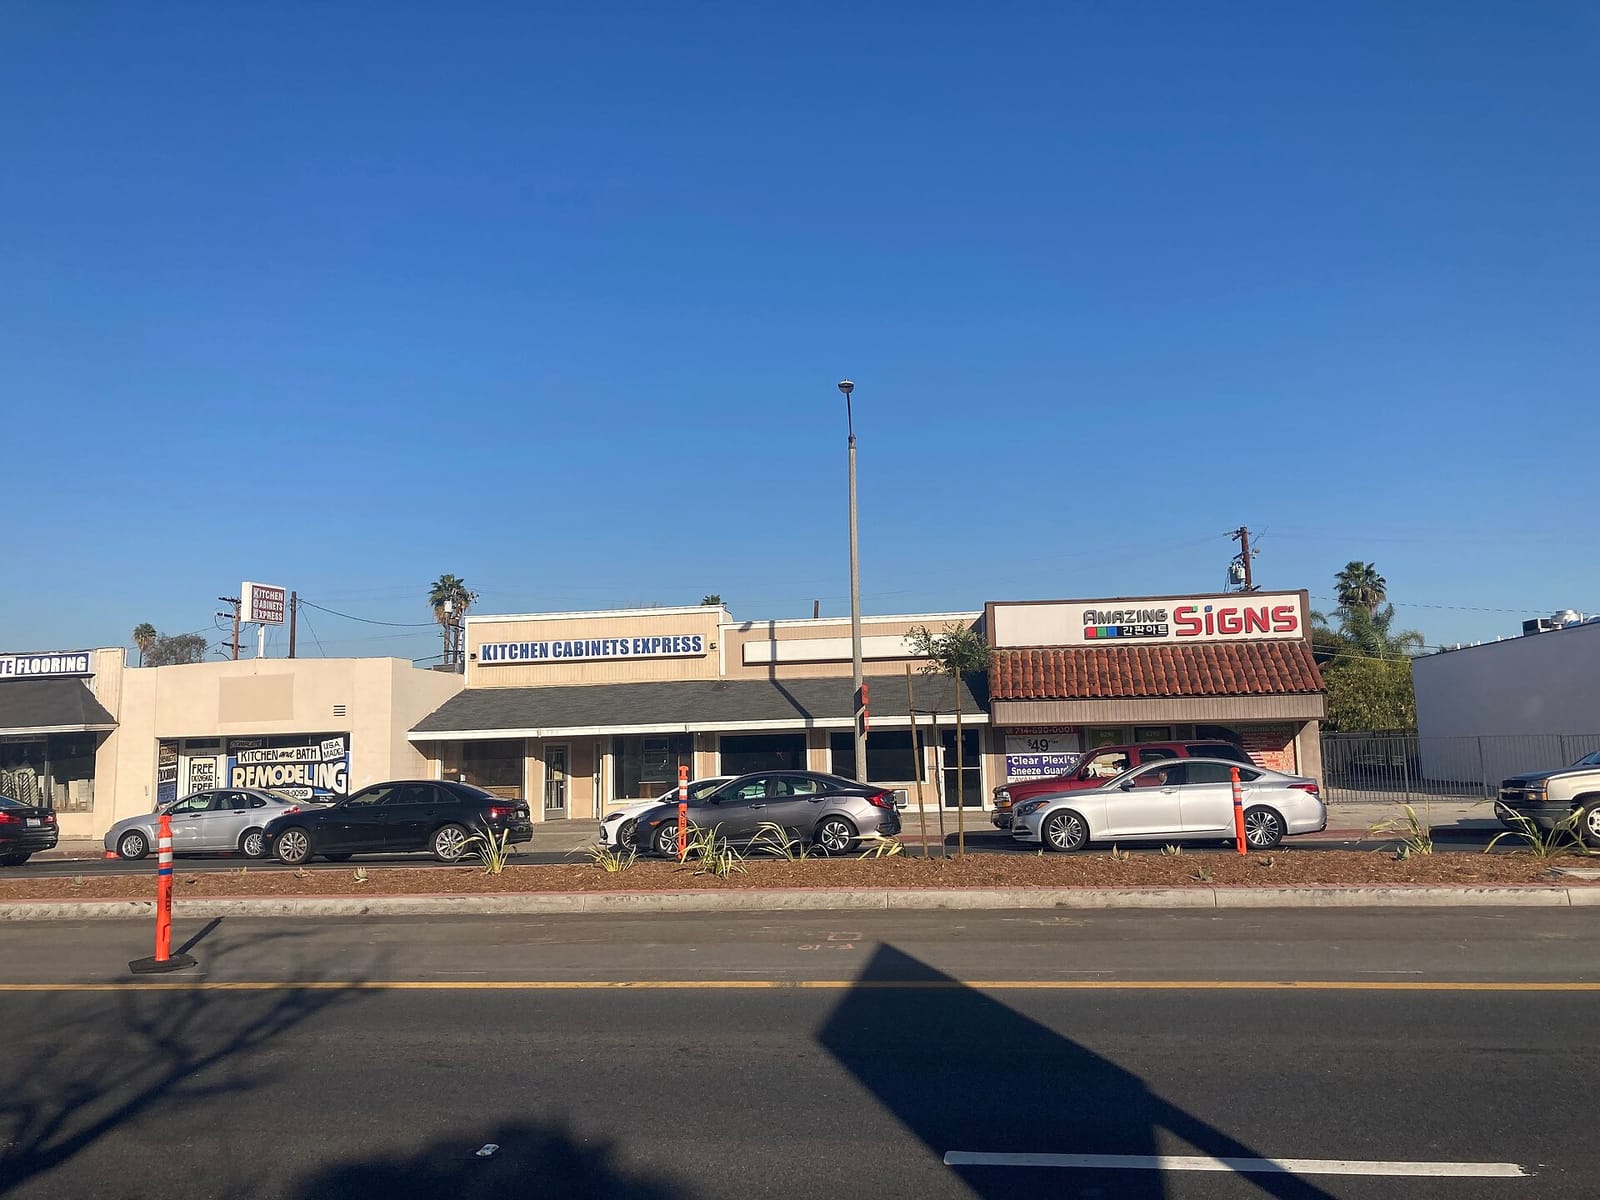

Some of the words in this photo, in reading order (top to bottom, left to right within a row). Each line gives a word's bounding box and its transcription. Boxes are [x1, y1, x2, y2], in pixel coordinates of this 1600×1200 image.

[253, 587, 284, 601] KITCHEN
[1083, 608, 1168, 625] AMAZING
[1121, 623, 1168, 637] 간판아트
[481, 642, 549, 660] KITCHEN
[552, 639, 630, 658] CABINETS
[633, 636, 702, 654] EXPRESS
[16, 656, 87, 674] FLOORING
[1027, 738, 1049, 752] $49
[240, 749, 279, 763] KITCHEN
[279, 751, 294, 759] and
[296, 748, 318, 761] BATH
[1011, 756, 1039, 766] Clear
[1042, 755, 1075, 766] Plexi's
[192, 763, 214, 775] FREE
[1011, 767, 1042, 776] Sneeze
[232, 762, 348, 795] REMODELING
